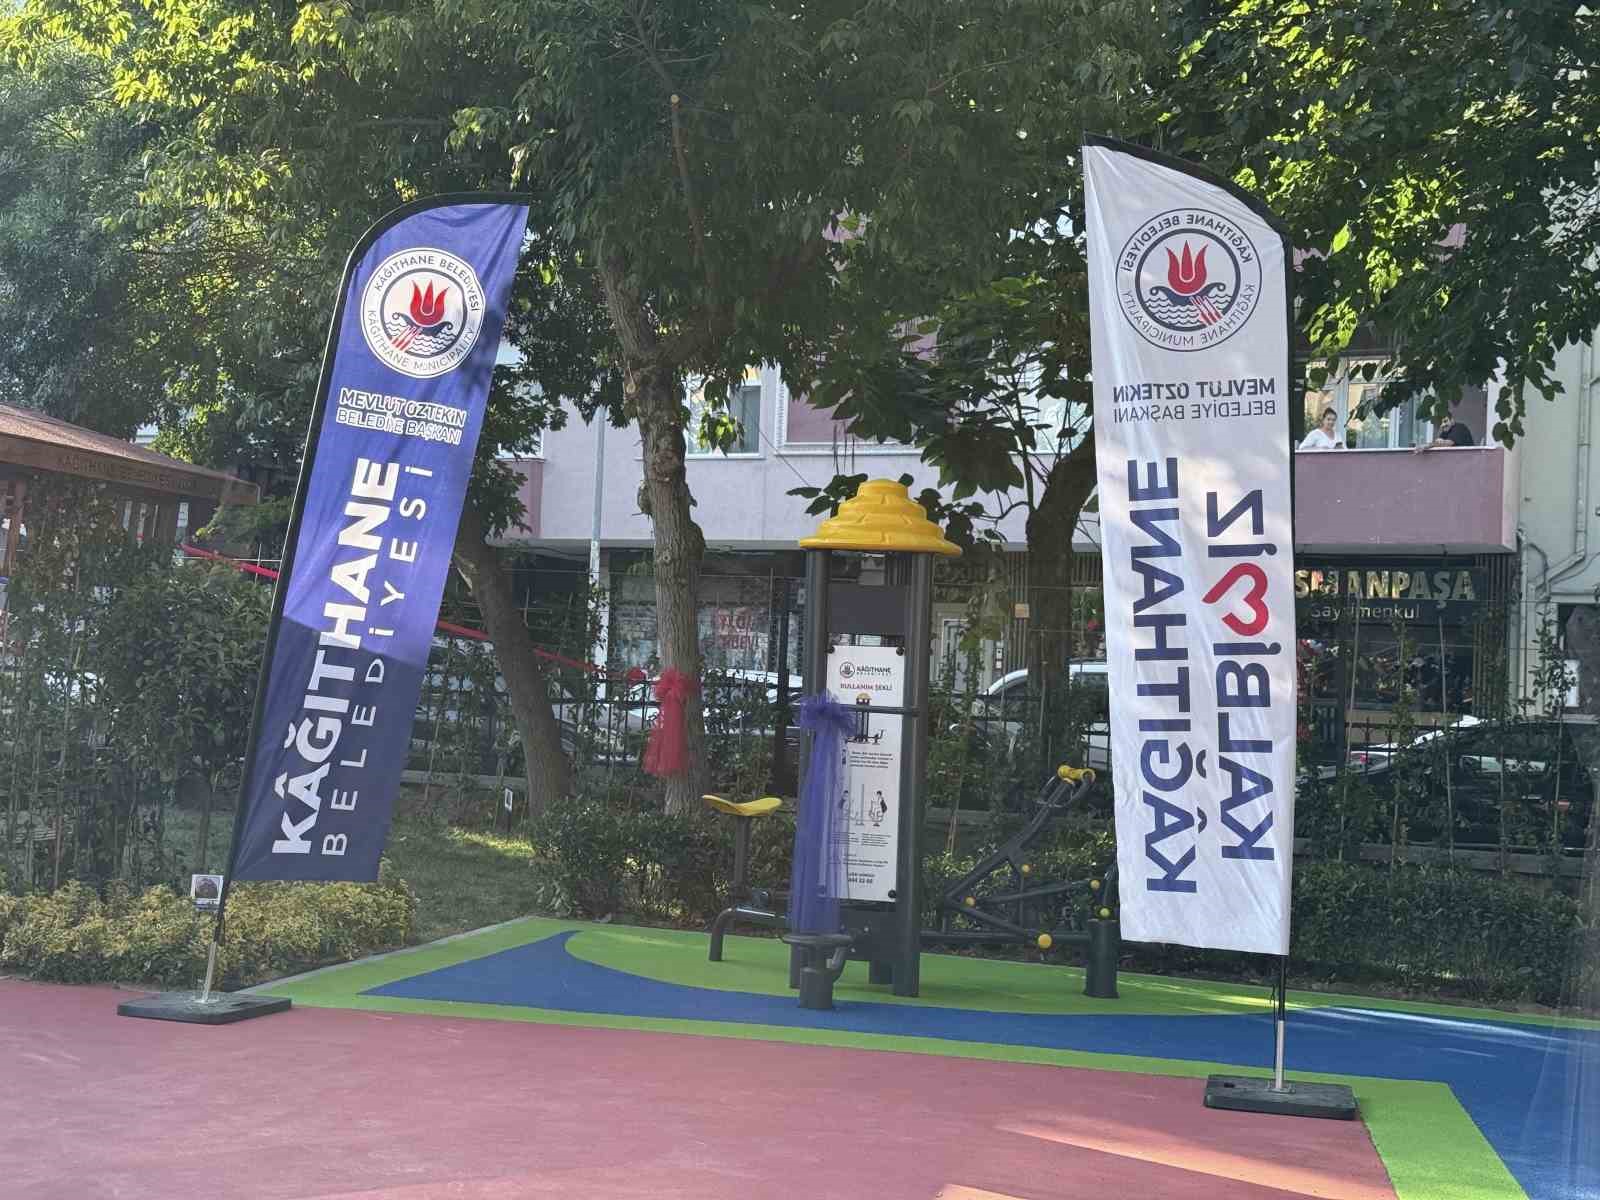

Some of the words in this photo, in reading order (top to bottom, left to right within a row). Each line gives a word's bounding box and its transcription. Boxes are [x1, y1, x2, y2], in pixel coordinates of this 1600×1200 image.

[406, 420, 462, 445] BAŞKANI
[272, 458, 399, 855] KÂĞITHANE
[322, 465, 433, 857] BELEDİYESİ
